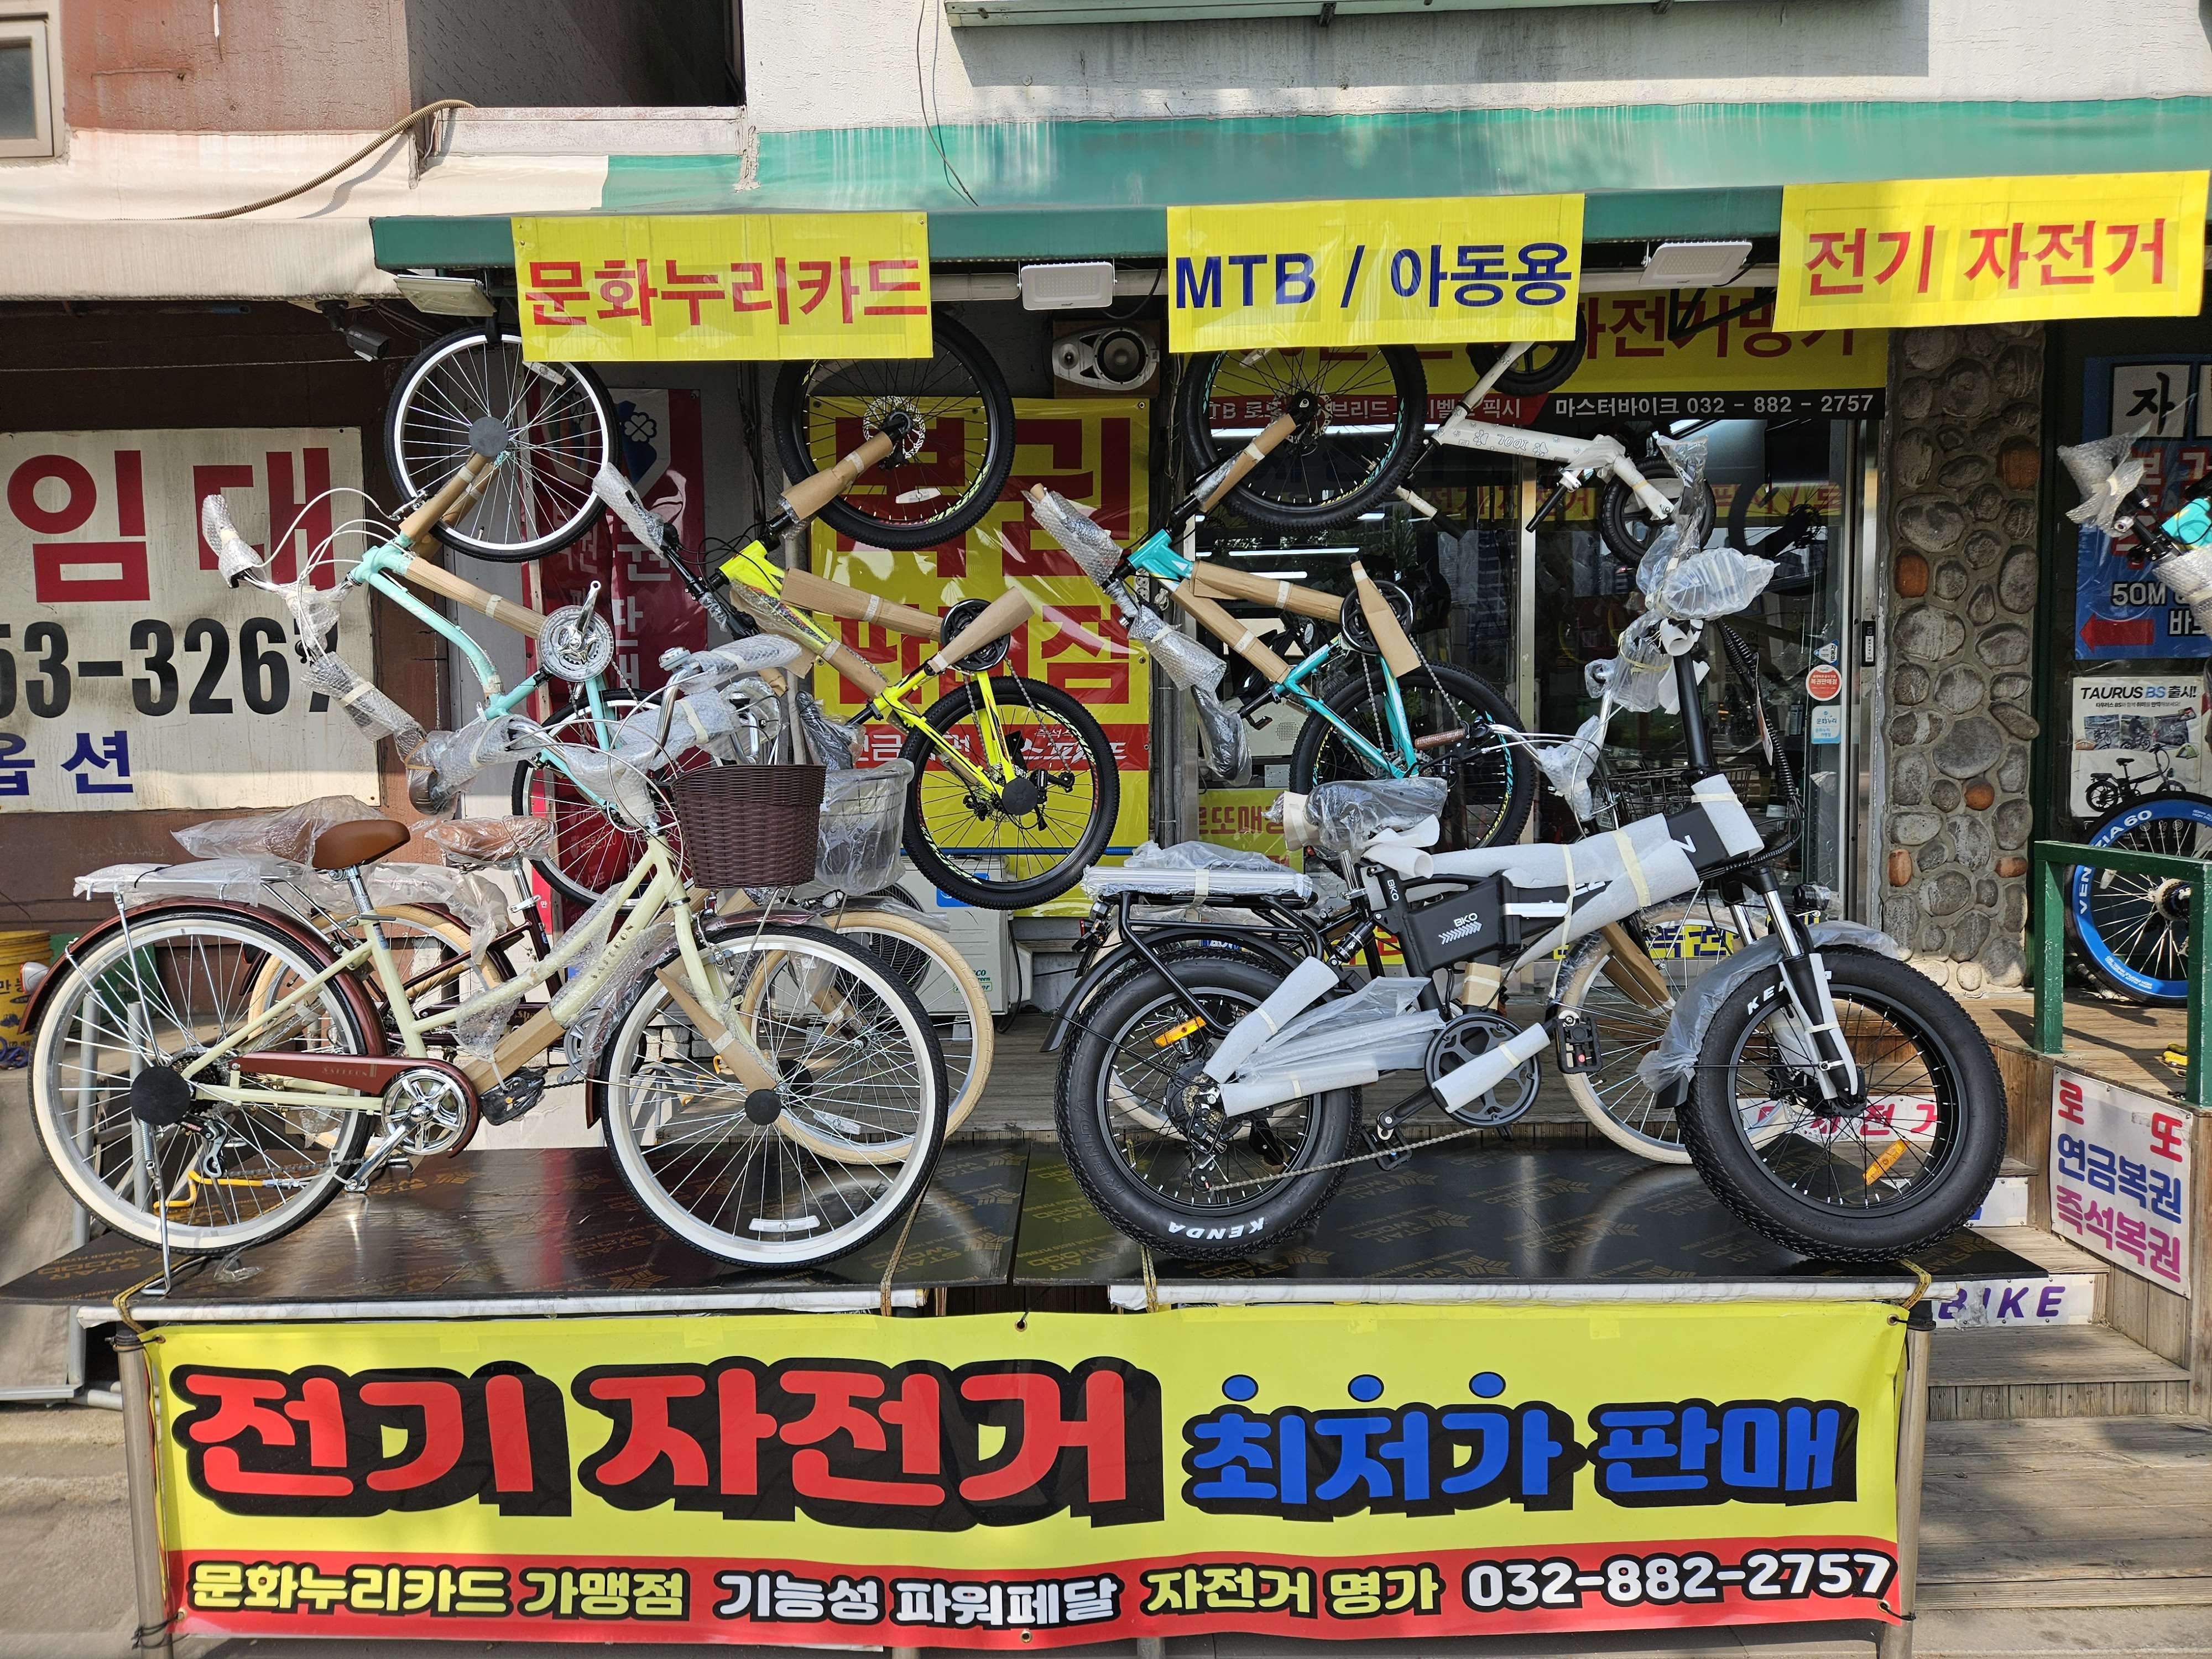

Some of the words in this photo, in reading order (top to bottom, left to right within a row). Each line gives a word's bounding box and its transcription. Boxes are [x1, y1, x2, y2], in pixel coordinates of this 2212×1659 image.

[1805, 225, 1934, 296] 전기
[1964, 218, 2166, 289] 자전거
[1176, 253, 1316, 309] MTB
[1340, 246, 1365, 308] /
[1391, 243, 1572, 307] 아동용
[525, 257, 927, 326] 문화누리카드
[1483, 398, 1520, 419] 픽시
[1555, 398, 1680, 417] 마스터바이크
[1687, 396, 1725, 414] 032
[1754, 396, 1792, 413] 882
[1820, 394, 1874, 412] 2757
[2112, 583, 2166, 605] 50M
[2080, 686, 2143, 699] TAURUS
[2145, 686, 2166, 698] BS
[2168, 686, 2198, 698] 출시!
[2124, 810, 2153, 827] 60
[1387, 879, 1399, 901] BKO
[1453, 912, 1478, 927] BKO
[2058, 1133, 2182, 1224] 연금복권
[1168, 1216, 1265, 1241] KENDA
[2056, 1185, 2182, 1284] 즉석복권
[185, 1374, 533, 1496] 전기
[589, 1368, 1126, 1507] 자전거
[1193, 1409, 1563, 1504] 최저가
[1598, 1407, 1839, 1492] 판매
[192, 1564, 507, 1613] 문화누리카드
[526, 1570, 683, 1618] 가맹점
[719, 1572, 878, 1620] 기능성
[895, 1577, 1118, 1626] 파워페달
[1146, 1567, 1311, 1614] 자전거
[1329, 1567, 1438, 1614] 명가
[1469, 1553, 1891, 1608] 032-882-2757
